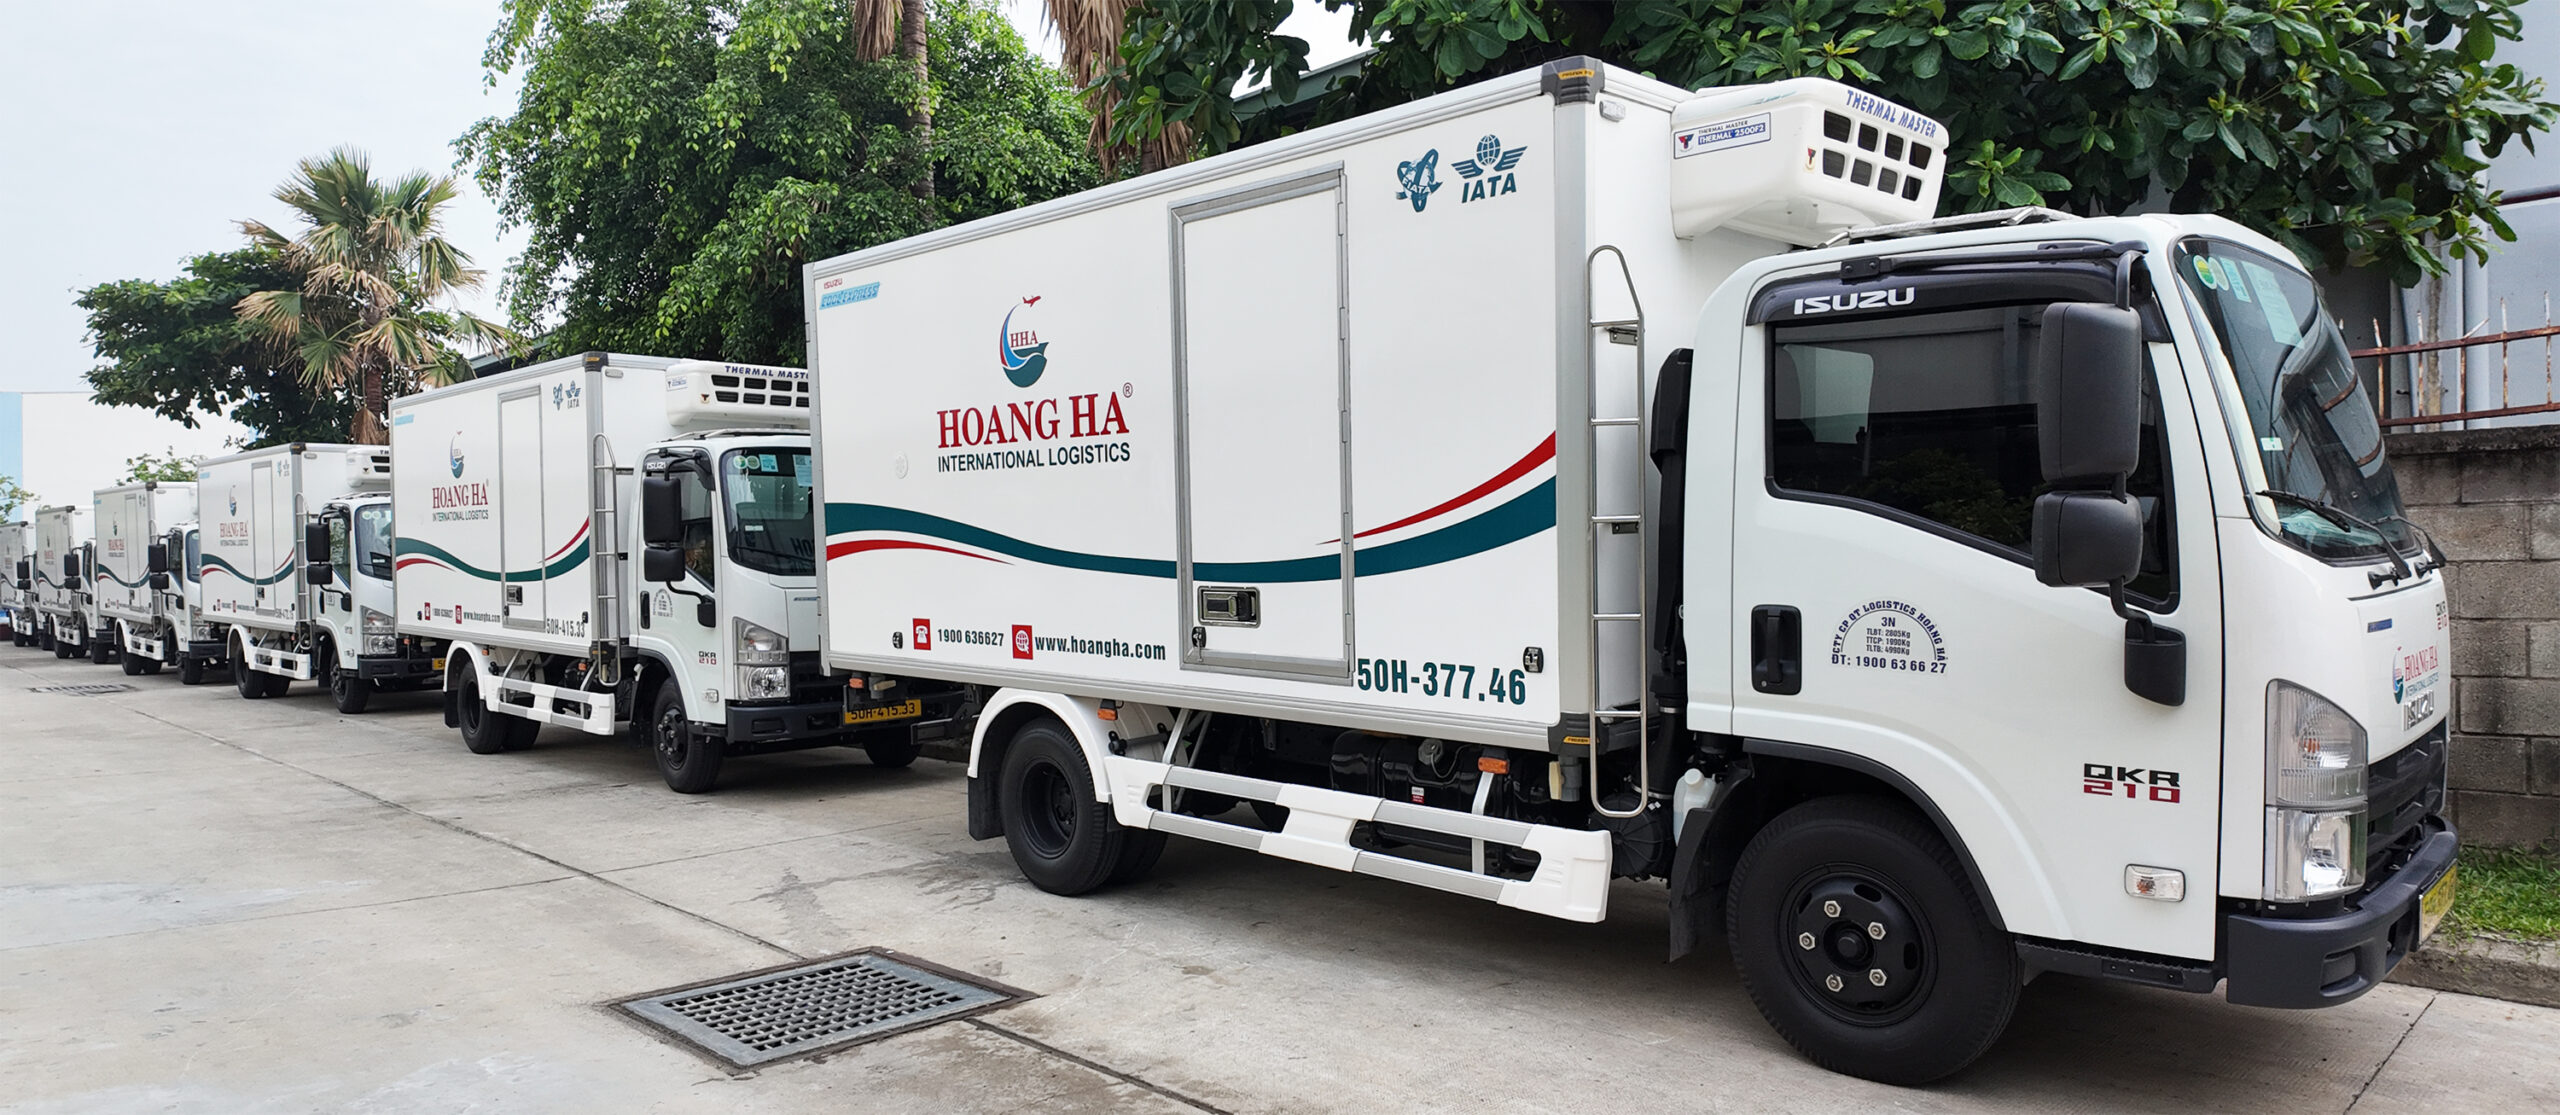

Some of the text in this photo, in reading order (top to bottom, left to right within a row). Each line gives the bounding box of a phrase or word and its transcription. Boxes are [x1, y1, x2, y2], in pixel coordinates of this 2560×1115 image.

[1846, 89, 1937, 138] THERMAL MASTER
[1699, 119, 1748, 135] THERMAL MASTER
[1699, 131, 1733, 145] THERMAL
[1401, 177, 1431, 195] FIATA
[1461, 172, 1517, 204] IATA
[1793, 287, 1915, 315] ISUZU
[1010, 330, 1039, 348] HHA
[725, 365, 774, 377] THERMAL
[937, 391, 1130, 449] HOANG HA
[938, 442, 1131, 473] INTERNATIONAL LOGISTICS
[432, 483, 489, 509] HOANG HA
[1862, 600, 1917, 616] LOGISTICS
[1881, 617, 1896, 628] 3N
[937, 628, 1004, 647] 1900 636627
[1034, 634, 1166, 661] www.hoangha.com
[1856, 656, 1887, 669] 1900
[1890, 659, 1907, 670] 63
[1910, 660, 1926, 672] 66
[1930, 662, 1947, 674] 27
[1357, 658, 1526, 705] 50H-377.46
[2083, 763, 2180, 788] QKR
[2083, 778, 2180, 804] 210
